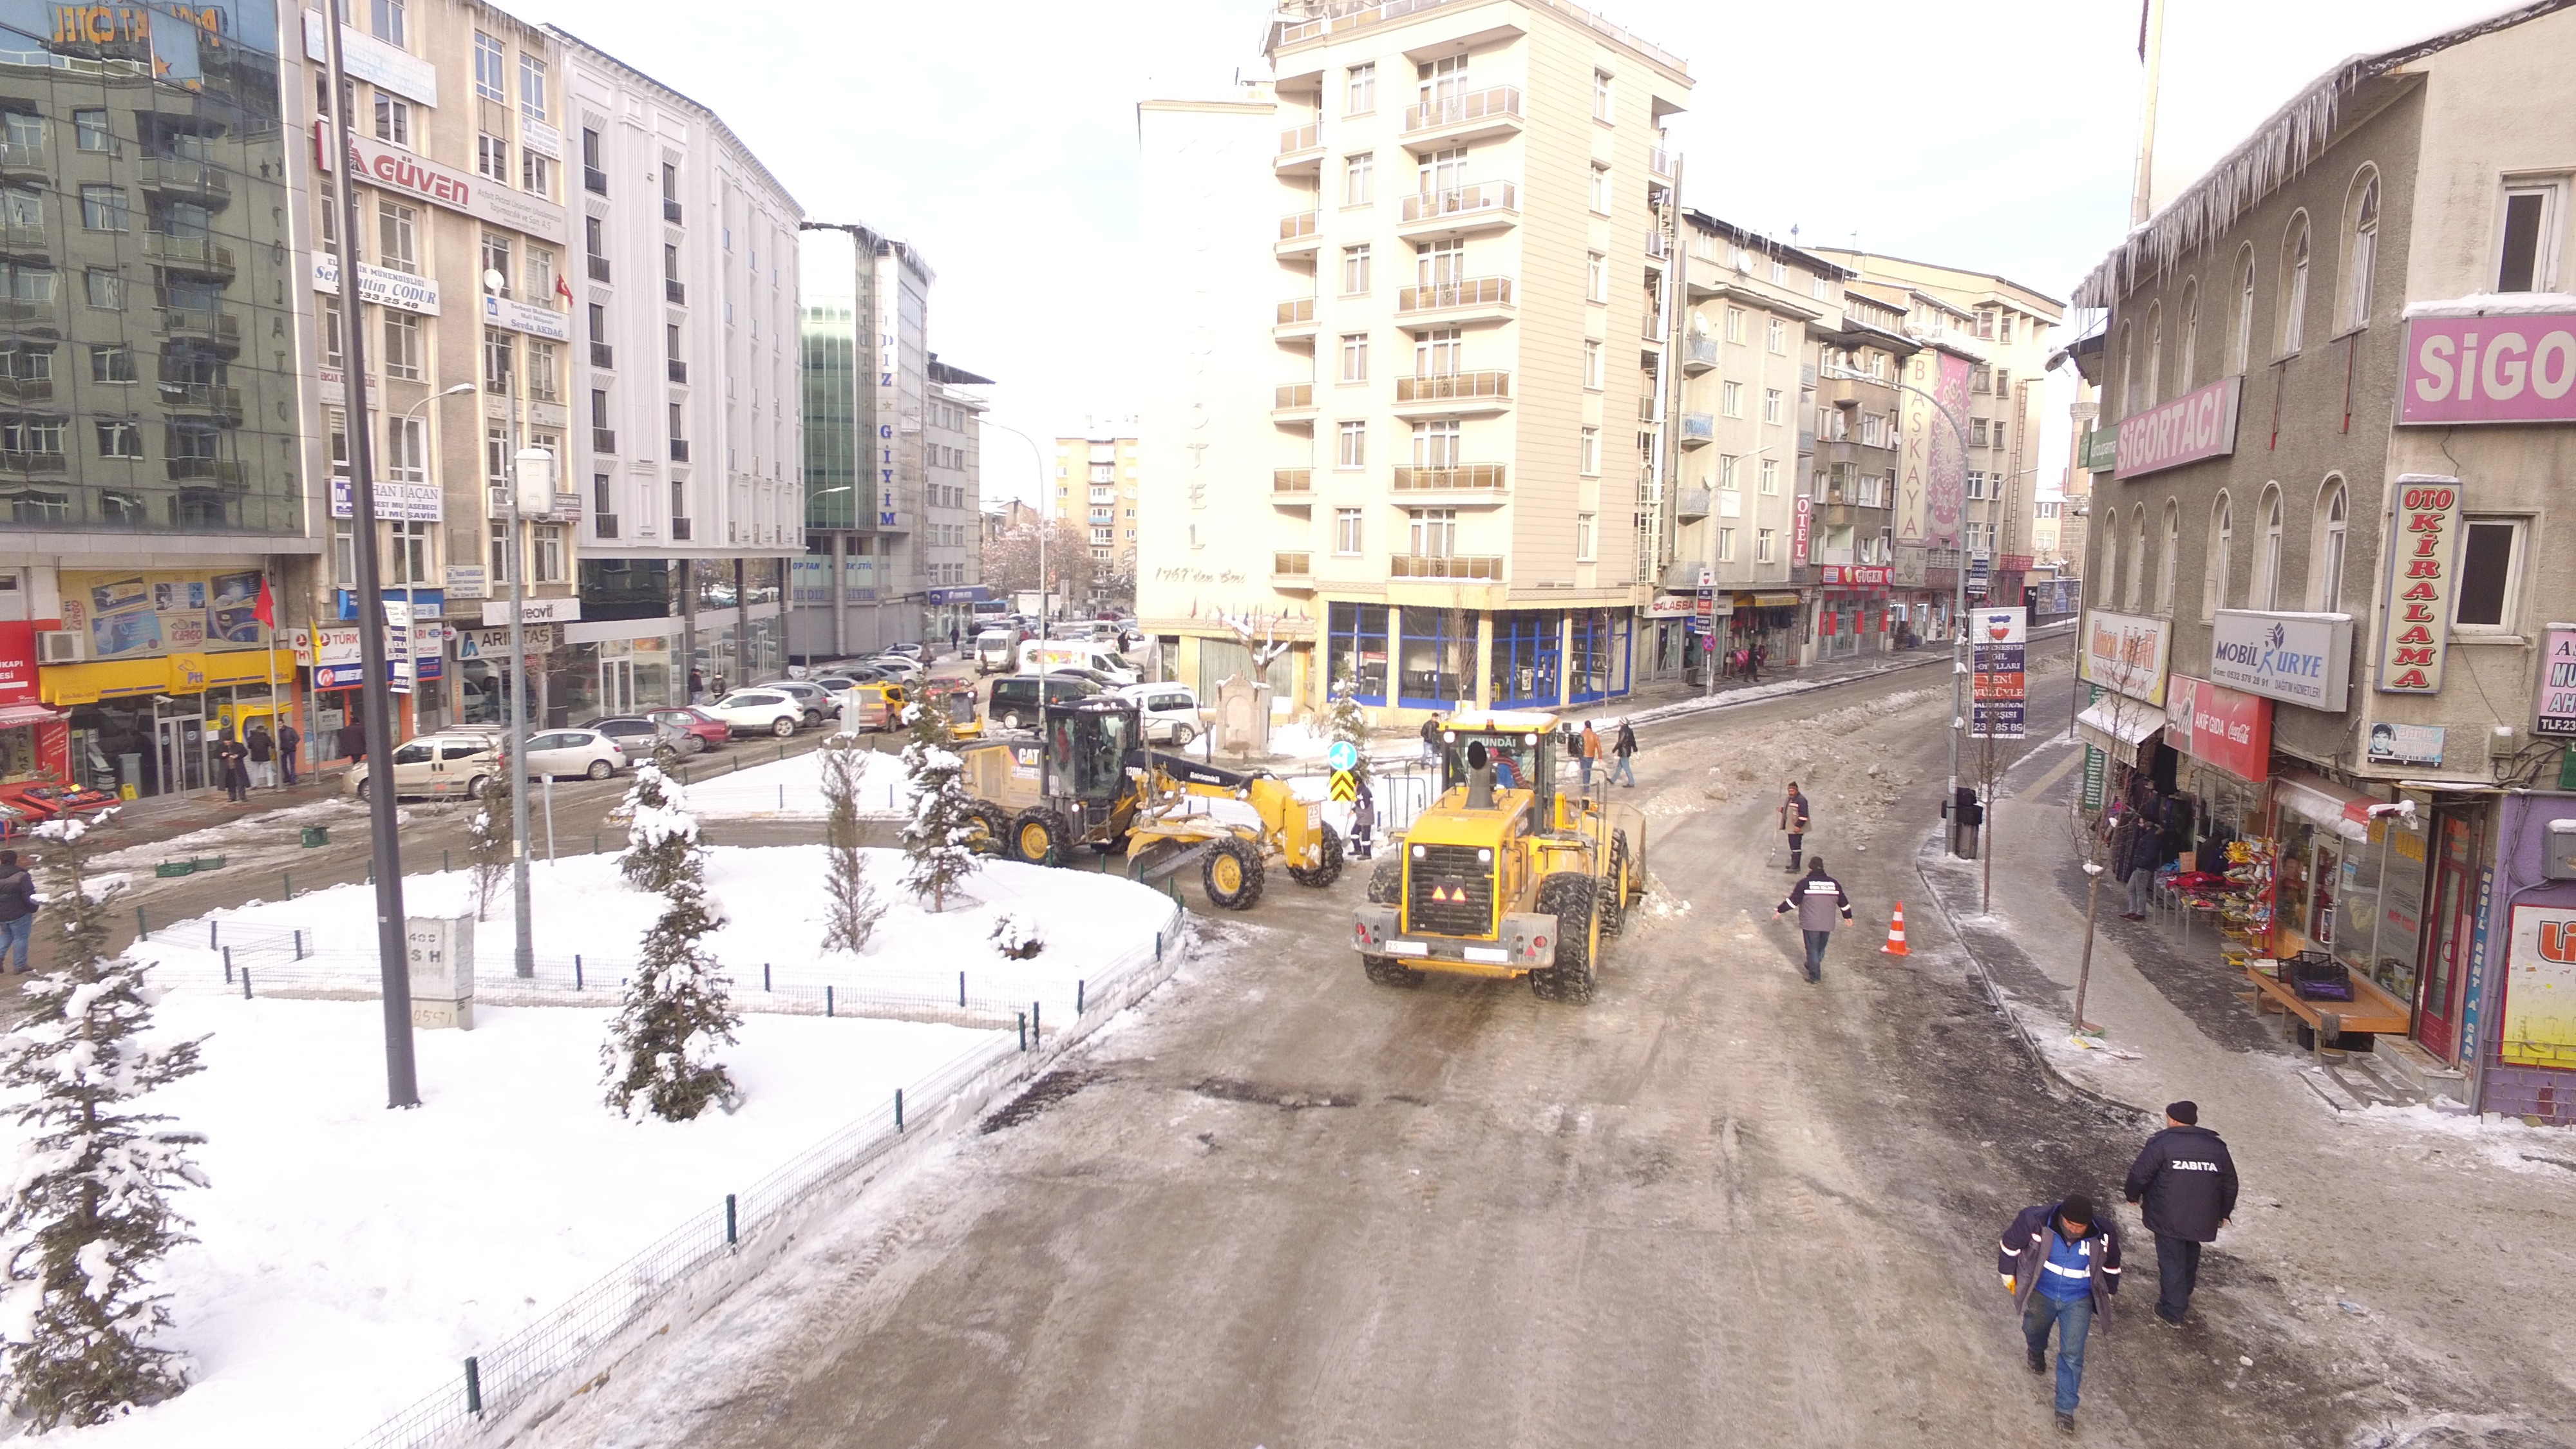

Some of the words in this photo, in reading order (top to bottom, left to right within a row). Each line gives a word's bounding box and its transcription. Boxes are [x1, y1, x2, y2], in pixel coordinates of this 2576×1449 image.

[374, 155, 469, 205] GÜVEN
[383, 296, 400, 305] 25
[392, 283, 437, 305] CODUR
[511, 319, 535, 331] Sevda
[1902, 359, 1926, 537] BAŞKAYA
[2403, 488, 2454, 511] OTO
[1797, 499, 1808, 558] OTEL
[1663, 600, 1694, 611] LASSA
[2392, 513, 2445, 688] KİRALAMA
[333, 631, 358, 645] TÜRK
[2215, 641, 2258, 667] MOBİL
[187, 672, 204, 683] Ptt
[2209, 716, 2224, 736] GIDA
[1019, 748, 1040, 764] CAT
[1309, 805, 1318, 817] 25
[1387, 942, 1398, 951] 25
[429, 950, 441, 963] H
[2463, 1023, 2476, 1058] CAR
[2172, 1160, 2219, 1173] ZABITA
